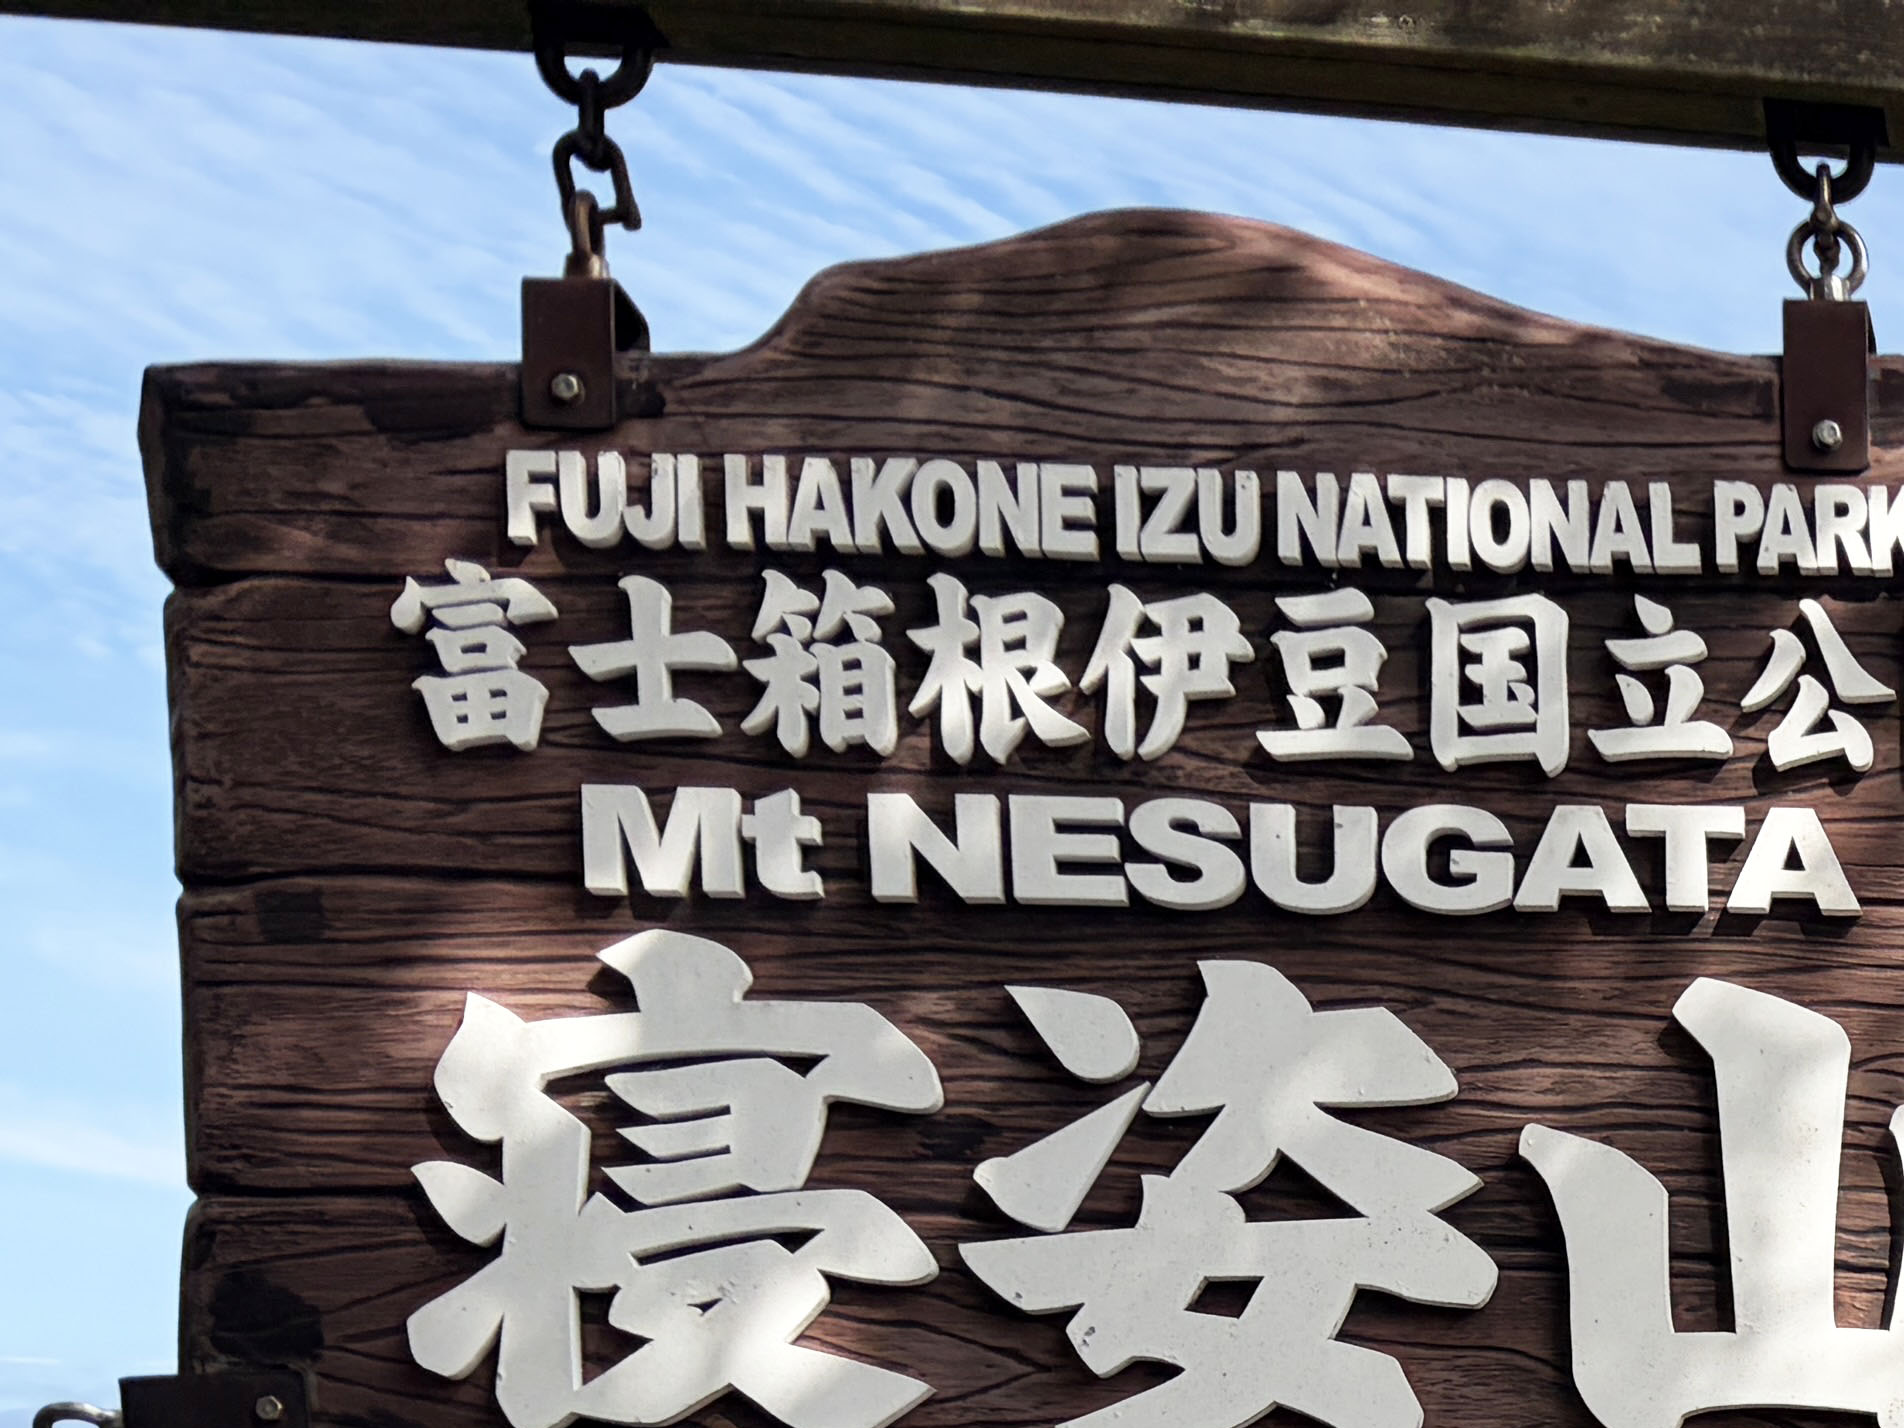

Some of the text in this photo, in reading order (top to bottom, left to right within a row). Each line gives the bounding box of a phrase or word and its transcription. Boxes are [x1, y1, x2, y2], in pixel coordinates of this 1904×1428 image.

[506, 449, 706, 547] FUJI
[723, 453, 1098, 556] HAKONE
[1113, 464, 1261, 562] IZU
[1276, 470, 1702, 570] NATIONAL
[581, 783, 1862, 914] Mt NESUGATA
